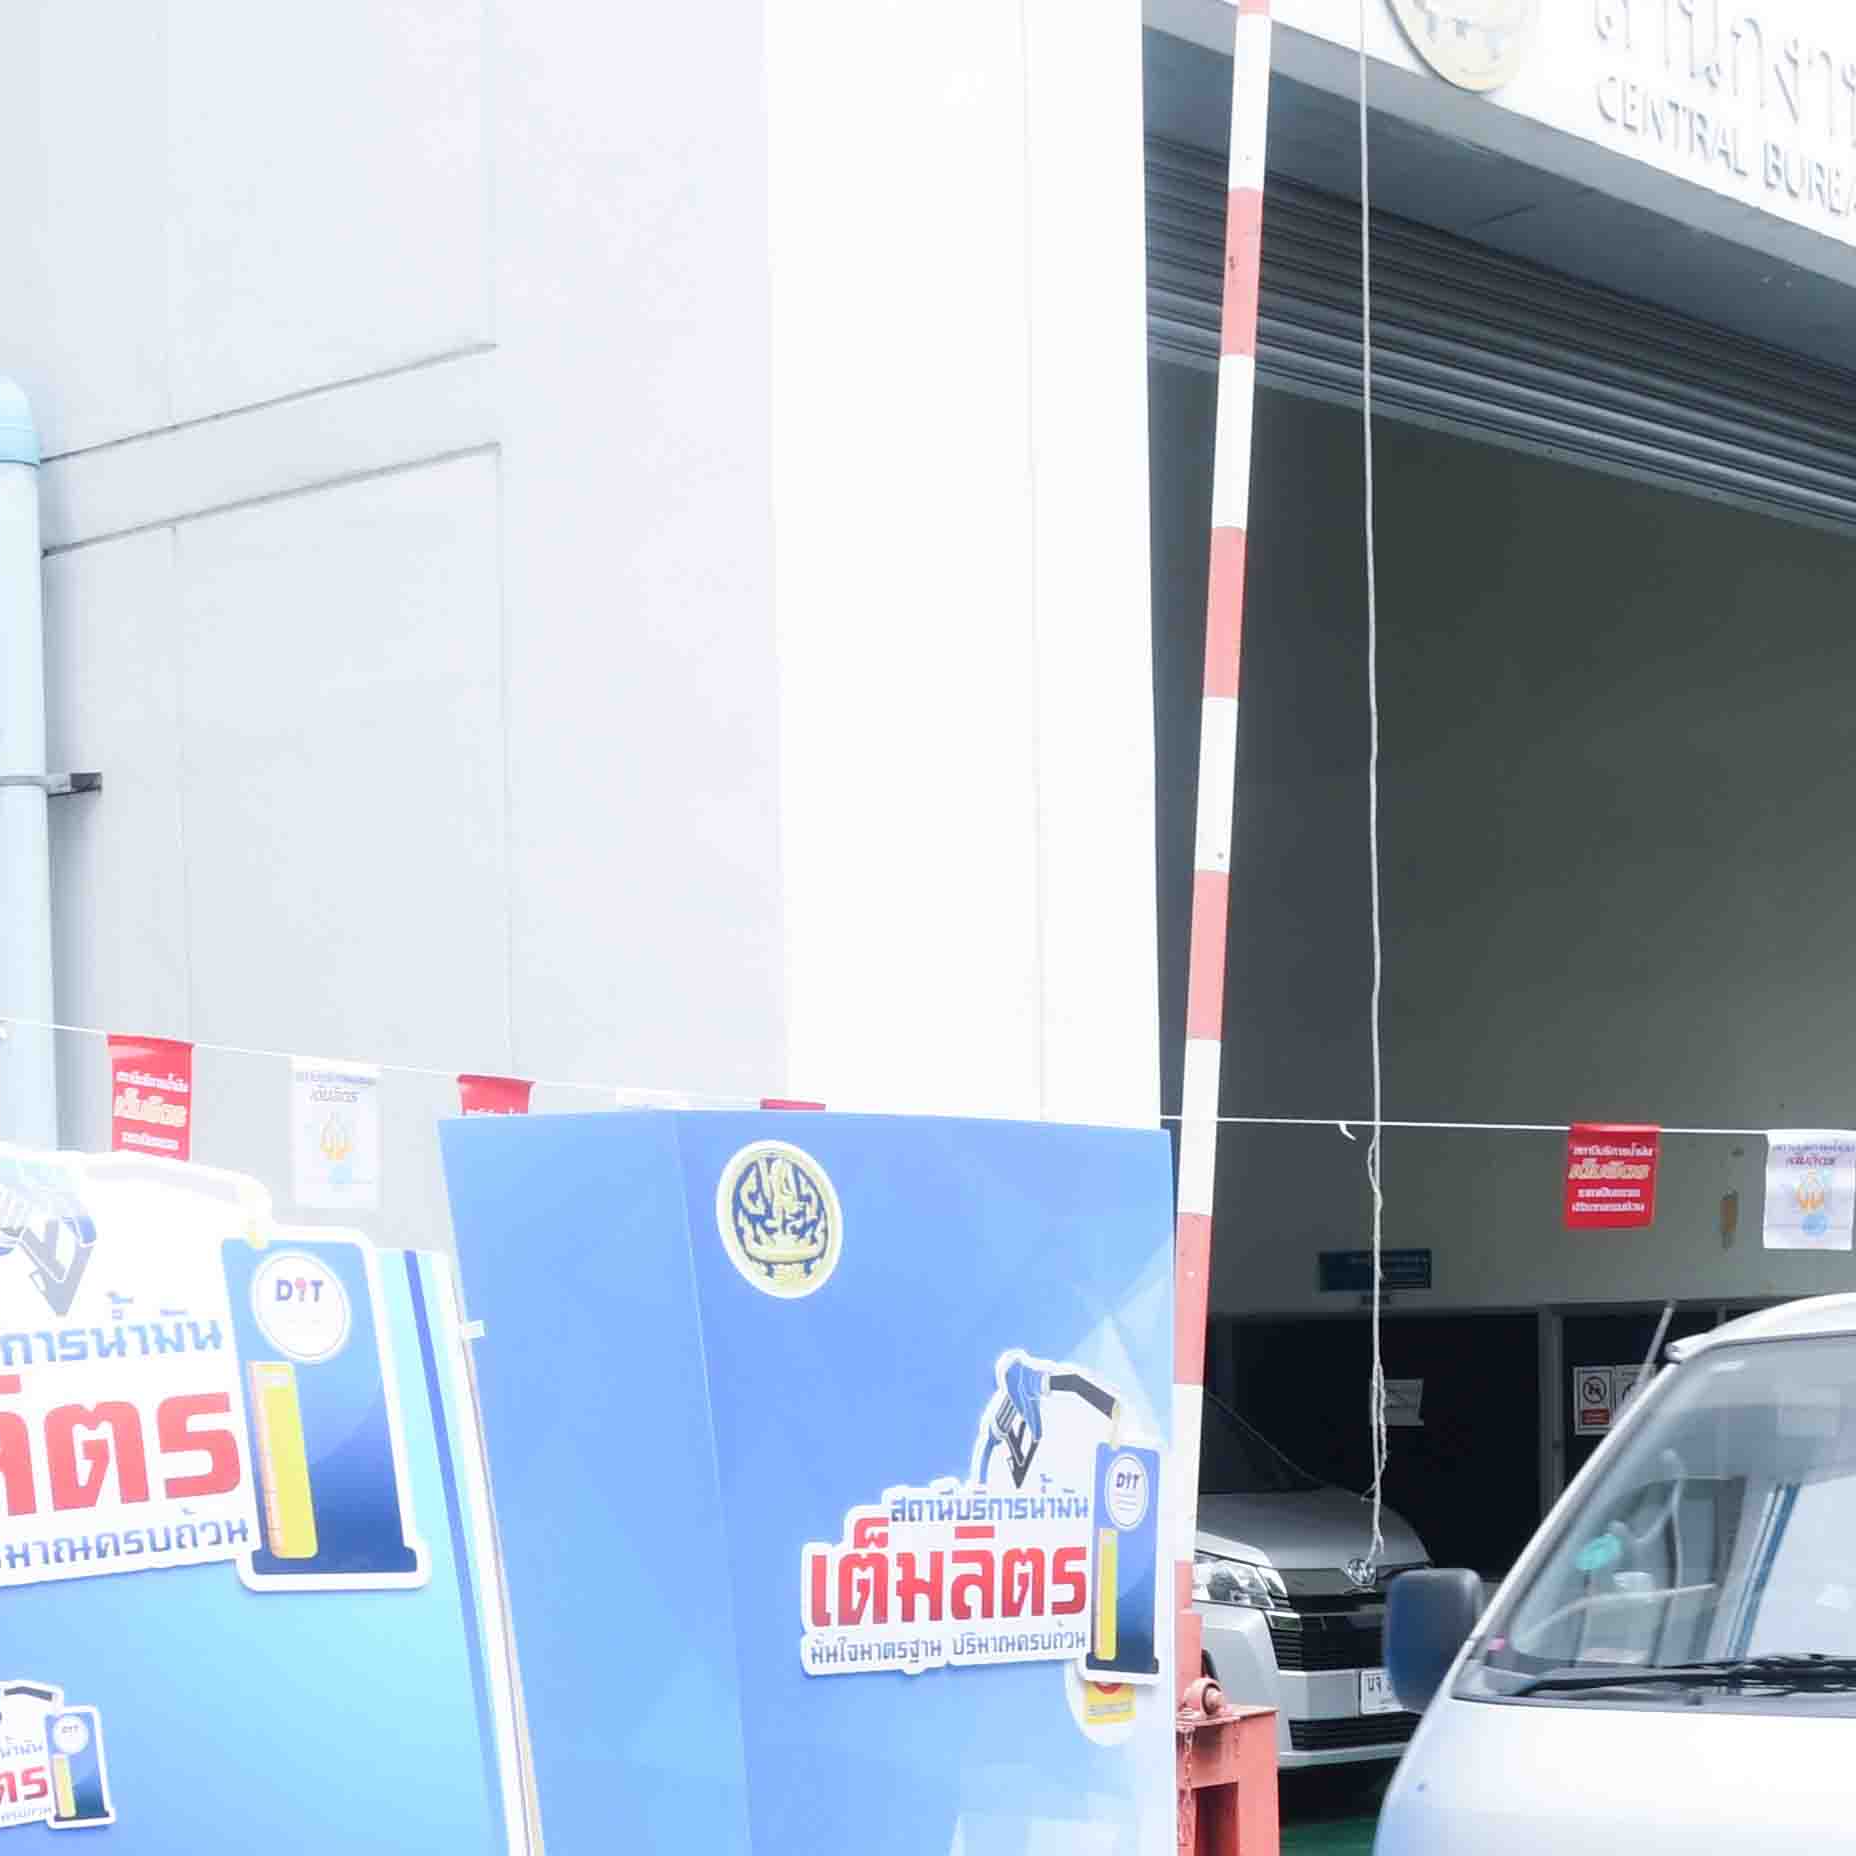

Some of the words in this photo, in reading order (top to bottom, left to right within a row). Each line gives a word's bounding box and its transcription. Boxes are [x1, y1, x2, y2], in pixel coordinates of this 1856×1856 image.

[1597, 75, 1749, 179] CENTRAL
[888, 1474, 1089, 1525] สถานีบริการน้ำมัน
[810, 1517, 1089, 1630] เต็มลิตร
[810, 1633, 943, 1666] มั่นใจมาตรฐาน
[952, 1624, 1087, 1657] ปริมาณครบถ้วน
